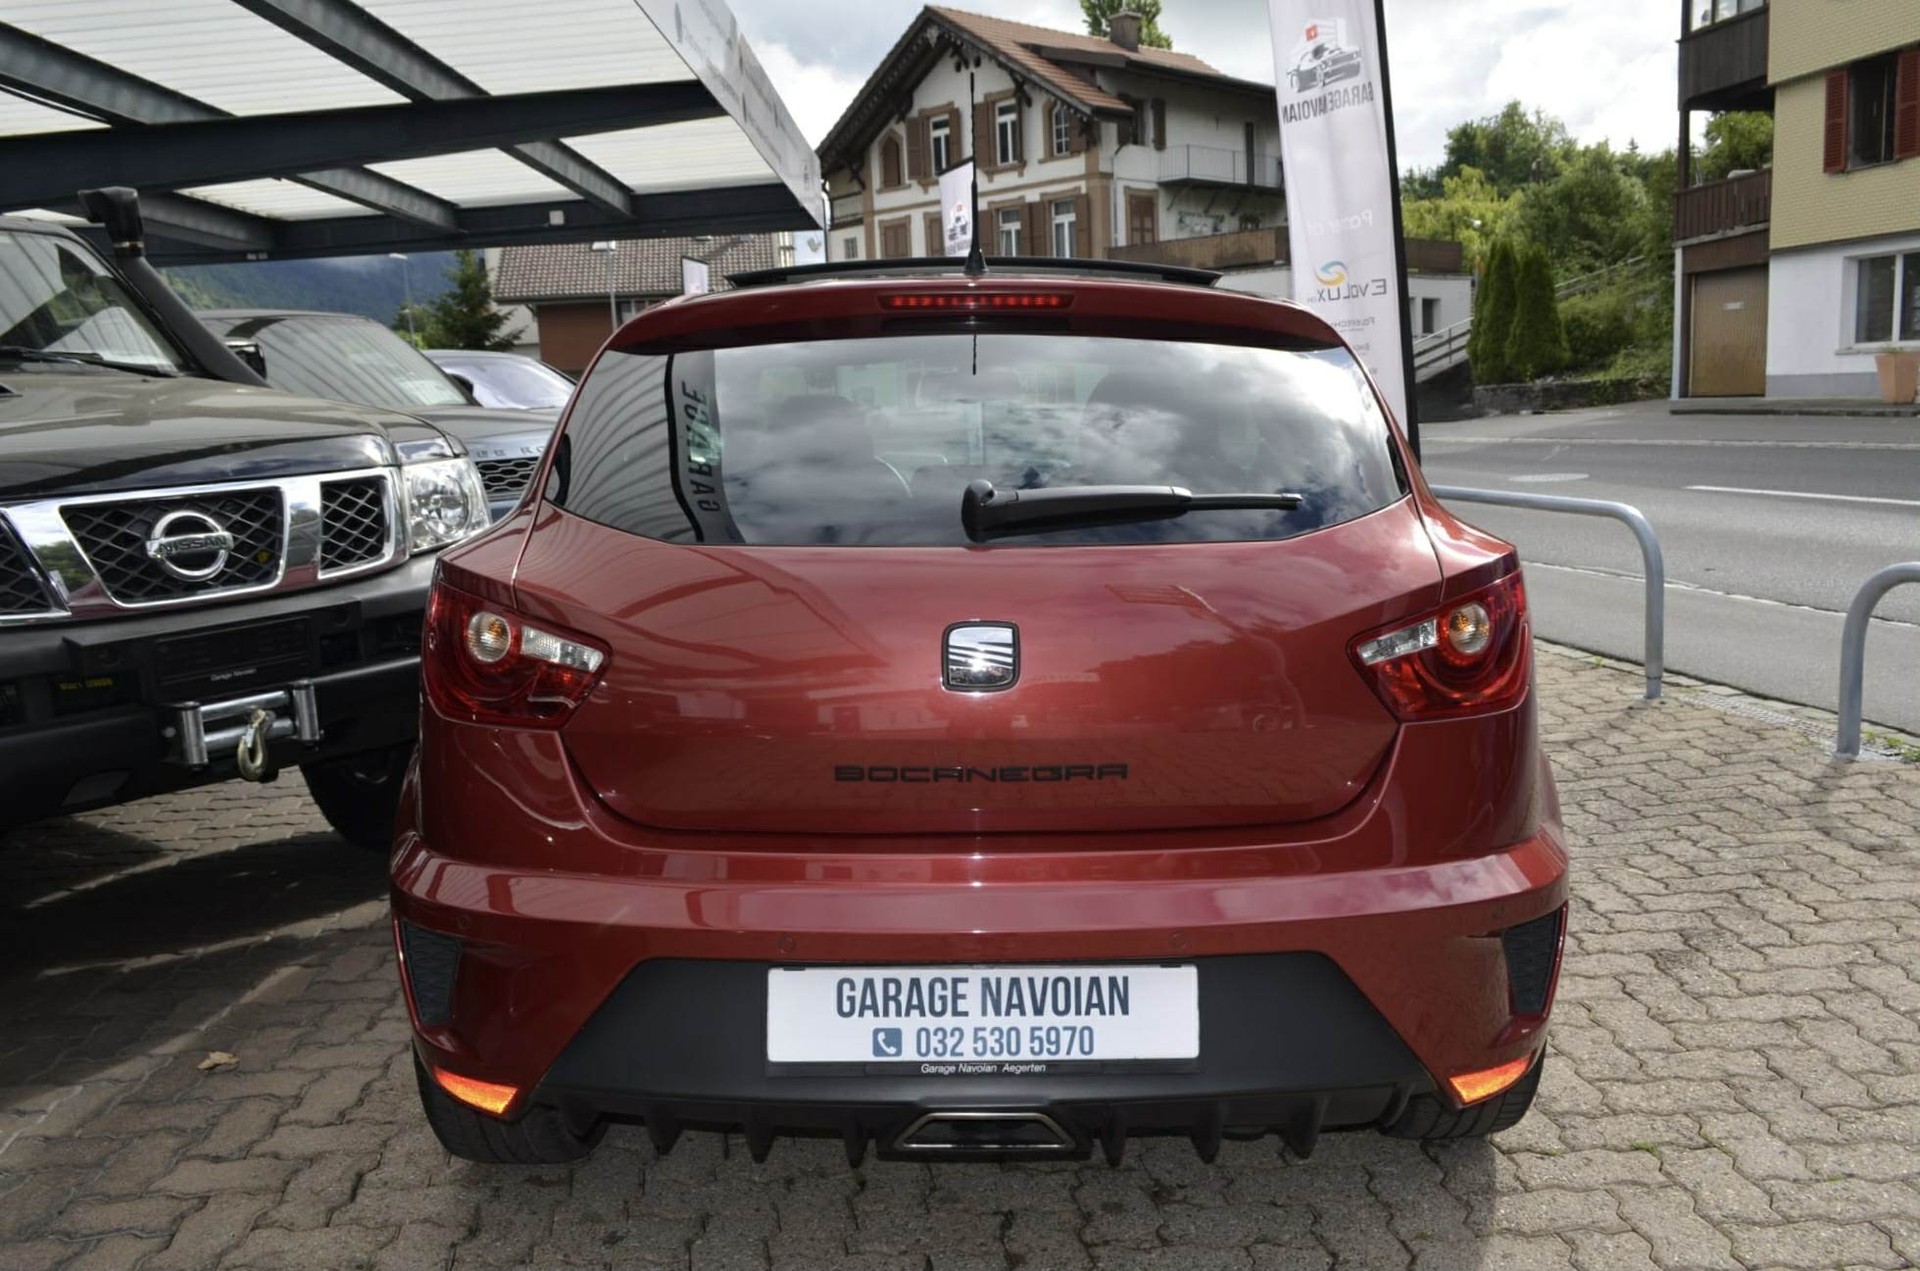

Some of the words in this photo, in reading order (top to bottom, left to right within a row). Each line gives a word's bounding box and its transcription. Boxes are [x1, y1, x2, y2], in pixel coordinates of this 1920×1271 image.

[155, 535, 228, 556] NISSAN
[834, 763, 1128, 782] BOCANEGRA
[836, 977, 969, 1018] GARAGE
[981, 976, 1130, 1017] NAVOIAN
[916, 1027, 965, 1057] 032
[972, 1026, 1021, 1056] 530
[1029, 1026, 1095, 1056] 5970
[921, 1063, 956, 1075] Garage
[958, 1063, 998, 1073] Navoian
[1001, 1063, 1047, 1074] Aegerten
